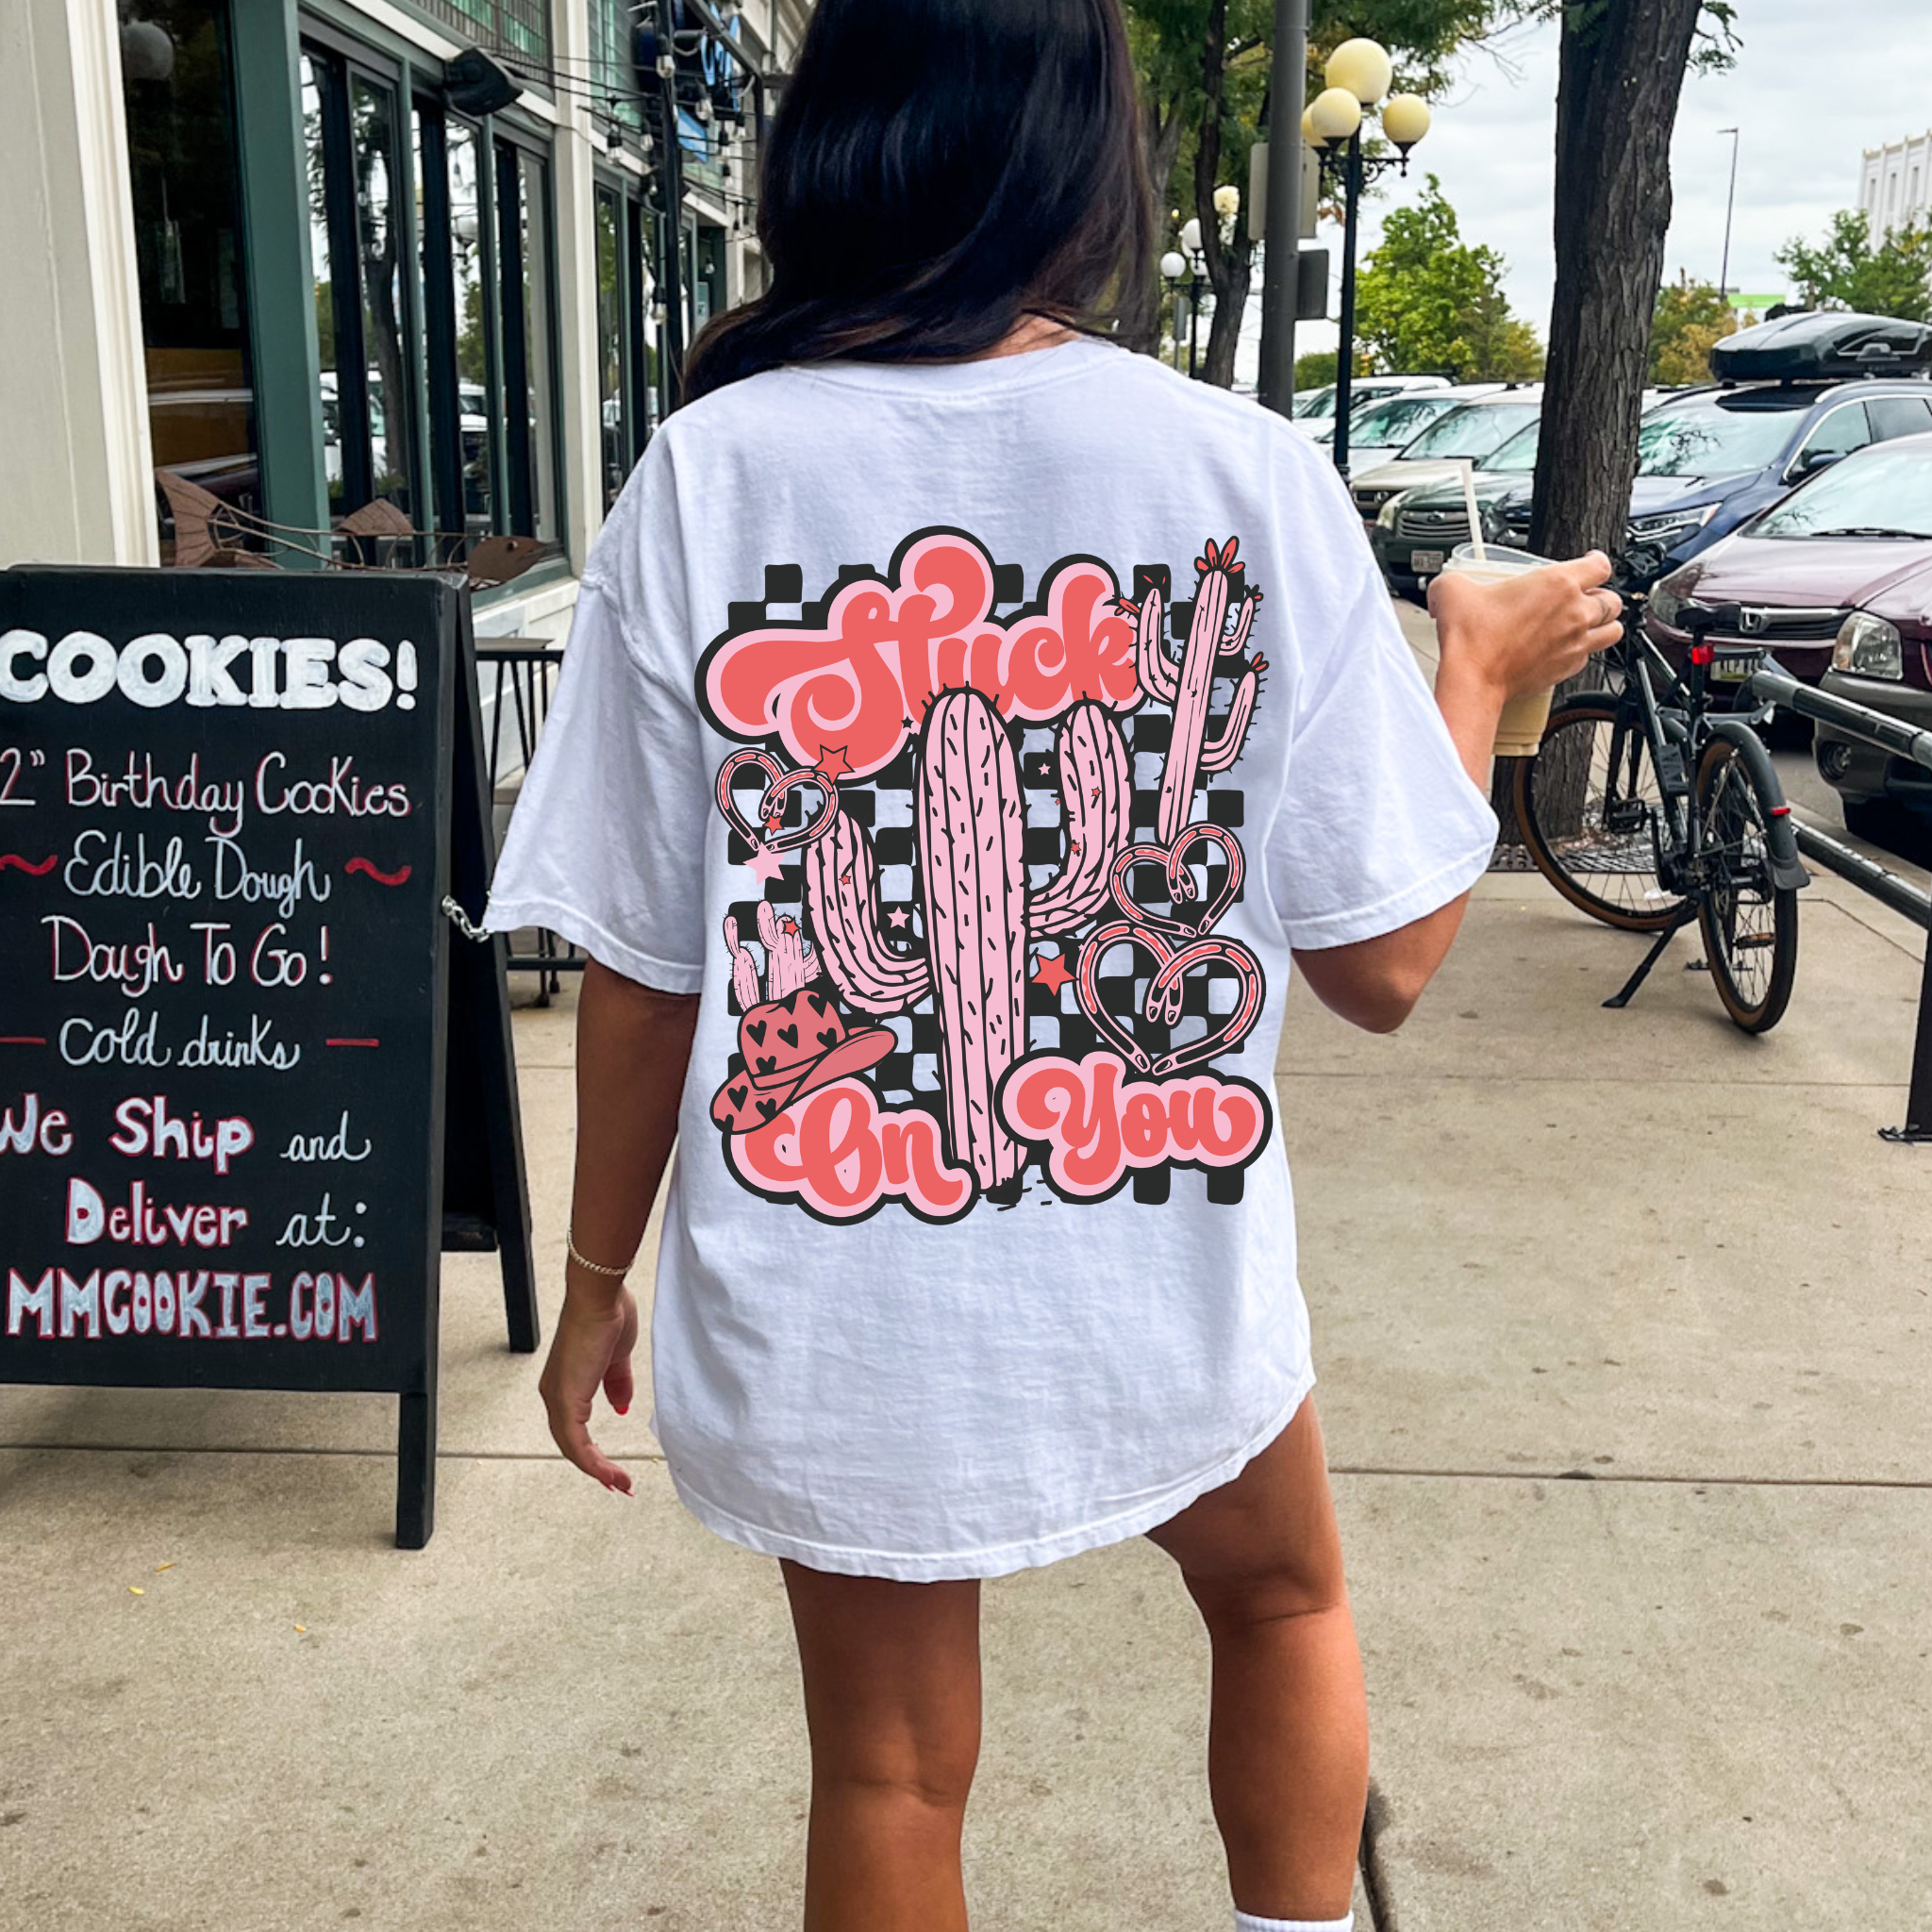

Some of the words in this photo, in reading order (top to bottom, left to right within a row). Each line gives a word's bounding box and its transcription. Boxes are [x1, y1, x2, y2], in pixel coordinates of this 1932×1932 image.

[0, 629, 417, 711] COOKIES!
[708, 538, 1141, 774] Stuck
[66, 748, 244, 836] Birthday
[65, 830, 201, 899] Edible
[205, 836, 330, 918] Dough
[42, 915, 184, 997] Dough
[190, 923, 236, 985] To
[59, 1008, 171, 1066] Cold
[0, 1092, 74, 1156] We
[108, 1094, 254, 1174] Ship
[280, 1110, 371, 1161] and
[739, 1082, 966, 1210] On
[1012, 1058, 1259, 1189] You
[66, 1176, 248, 1247] Deliver
[275, 1192, 366, 1247] at:
[6, 1267, 378, 1342] MMCOOKIE.COM
